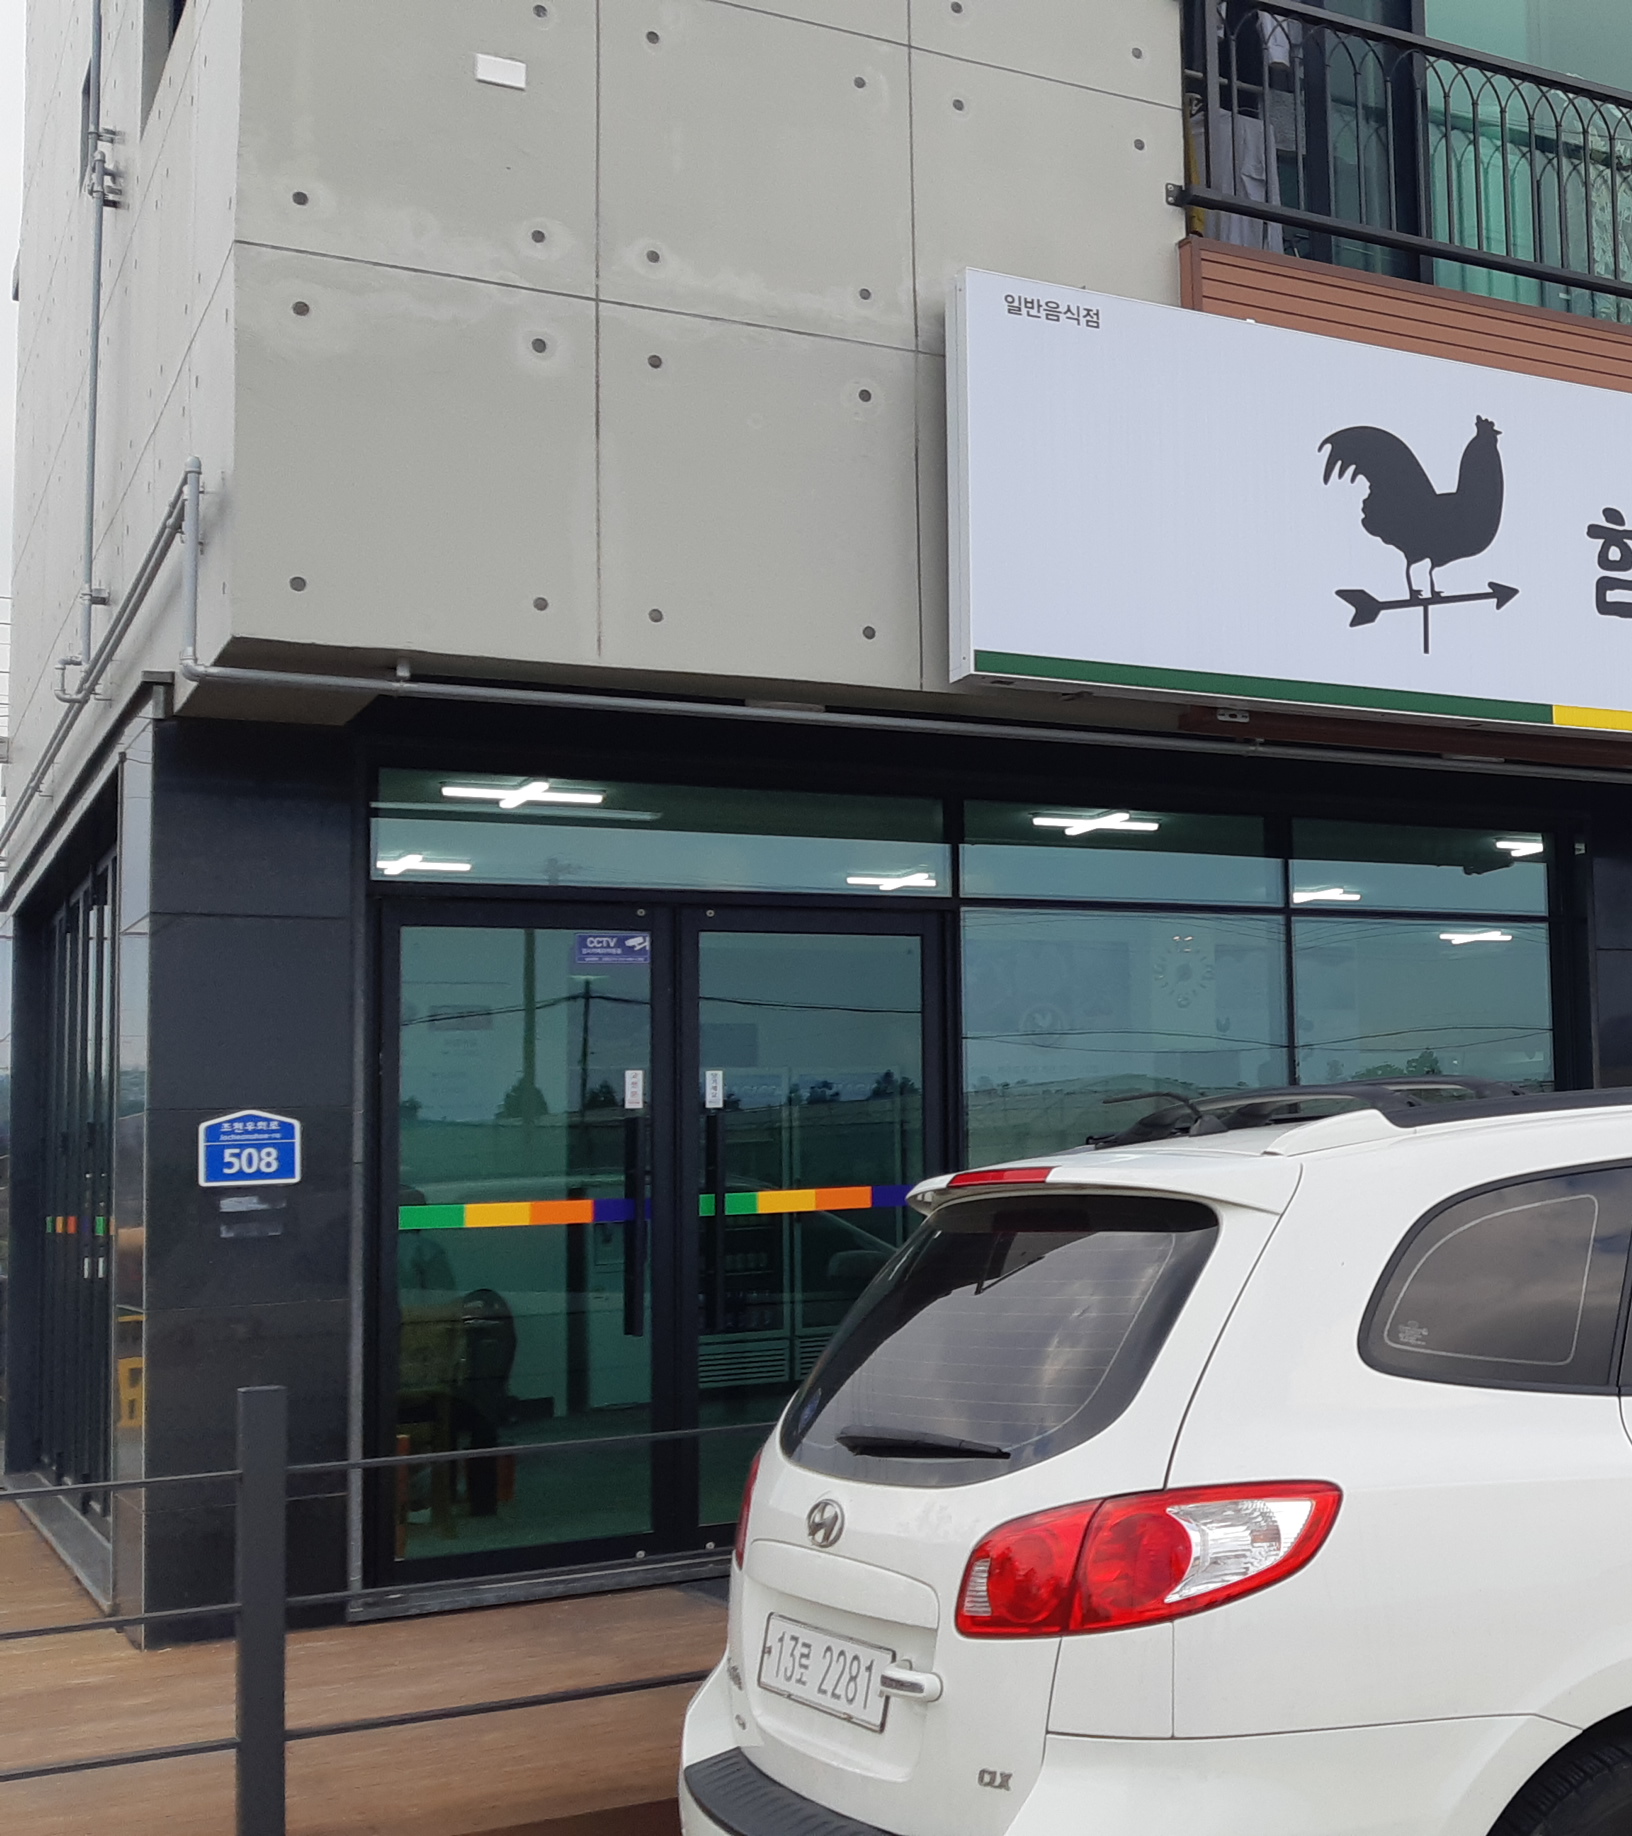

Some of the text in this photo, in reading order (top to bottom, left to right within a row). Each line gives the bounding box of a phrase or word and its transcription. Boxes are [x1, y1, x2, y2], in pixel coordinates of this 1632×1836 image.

[1003, 291, 1101, 329] 일반음식점
[586, 937, 617, 947] CCTV
[222, 1147, 279, 1174] 508
[775, 1630, 812, 1687] 13로
[817, 1644, 875, 1710] 2281
[977, 1767, 1013, 1792] CLX
